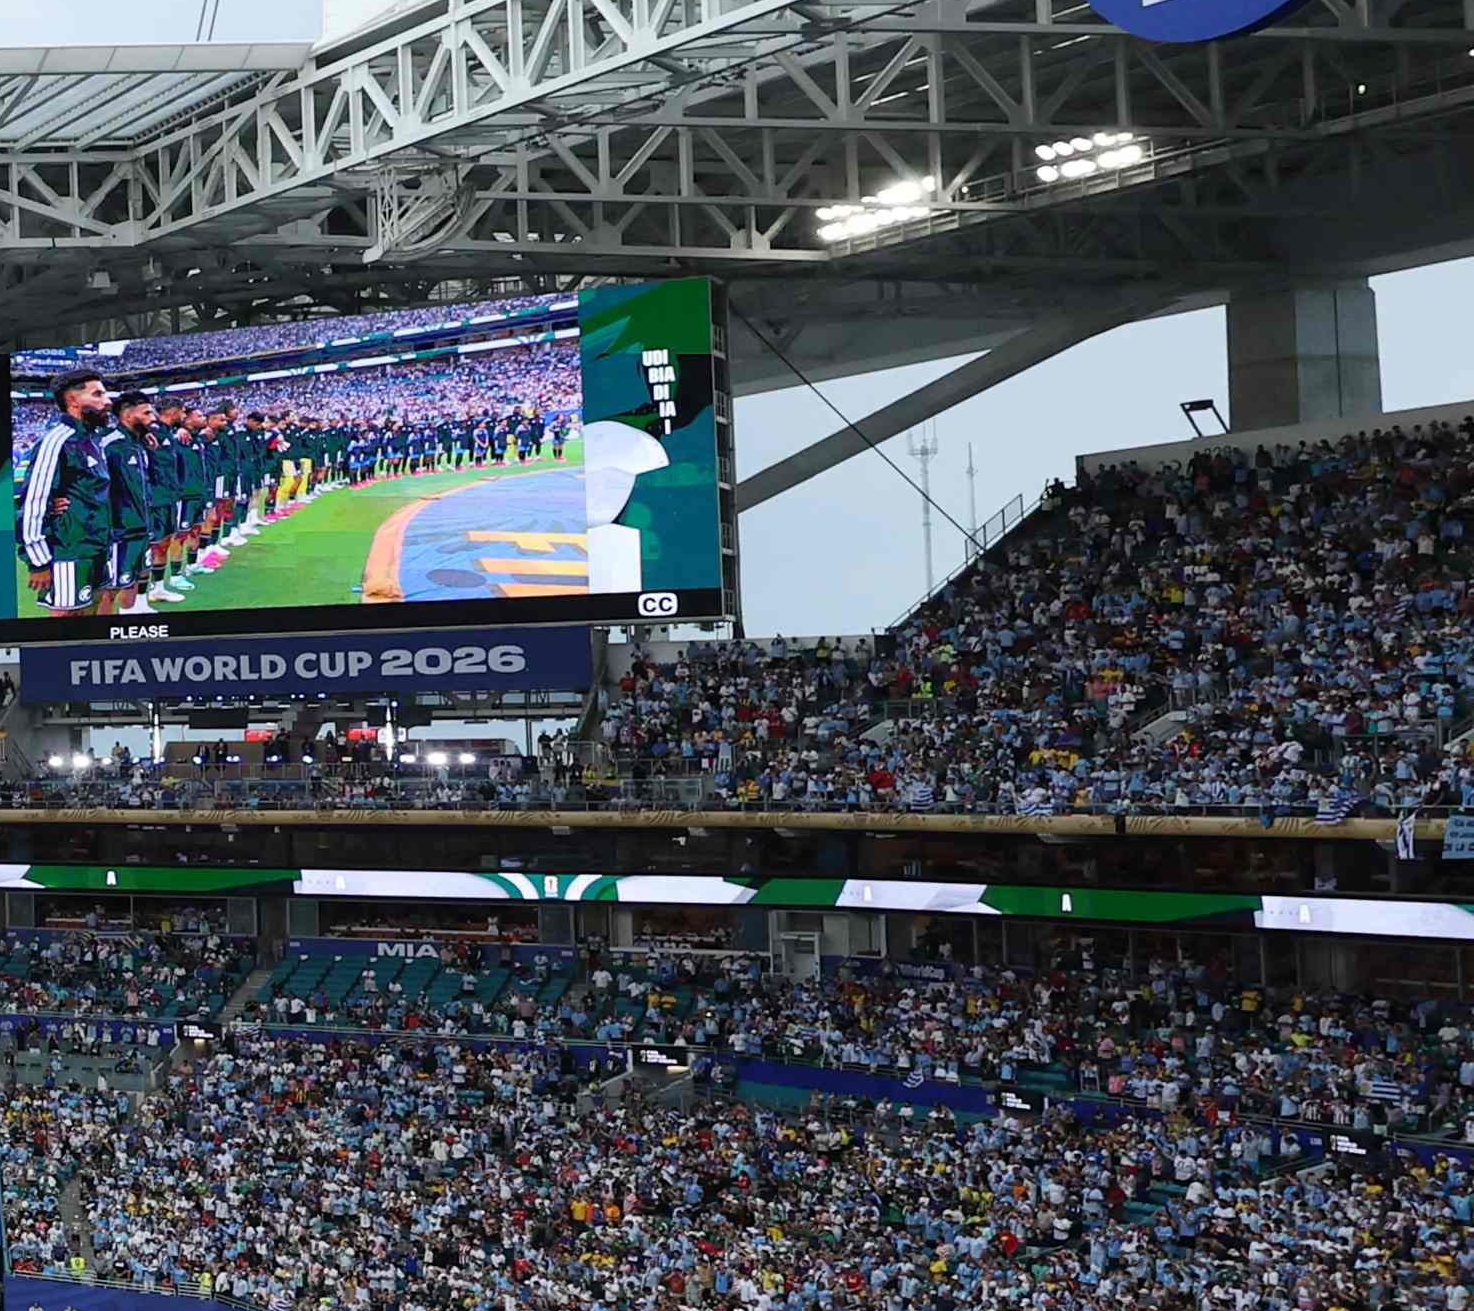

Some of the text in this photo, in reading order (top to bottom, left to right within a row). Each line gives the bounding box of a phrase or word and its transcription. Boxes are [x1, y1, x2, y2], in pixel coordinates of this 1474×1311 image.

[643, 598, 673, 613] CC
[111, 625, 169, 639] PLEASE
[70, 644, 527, 685] FIFA WORLD CUP 2026
[378, 942, 441, 958] MIA
